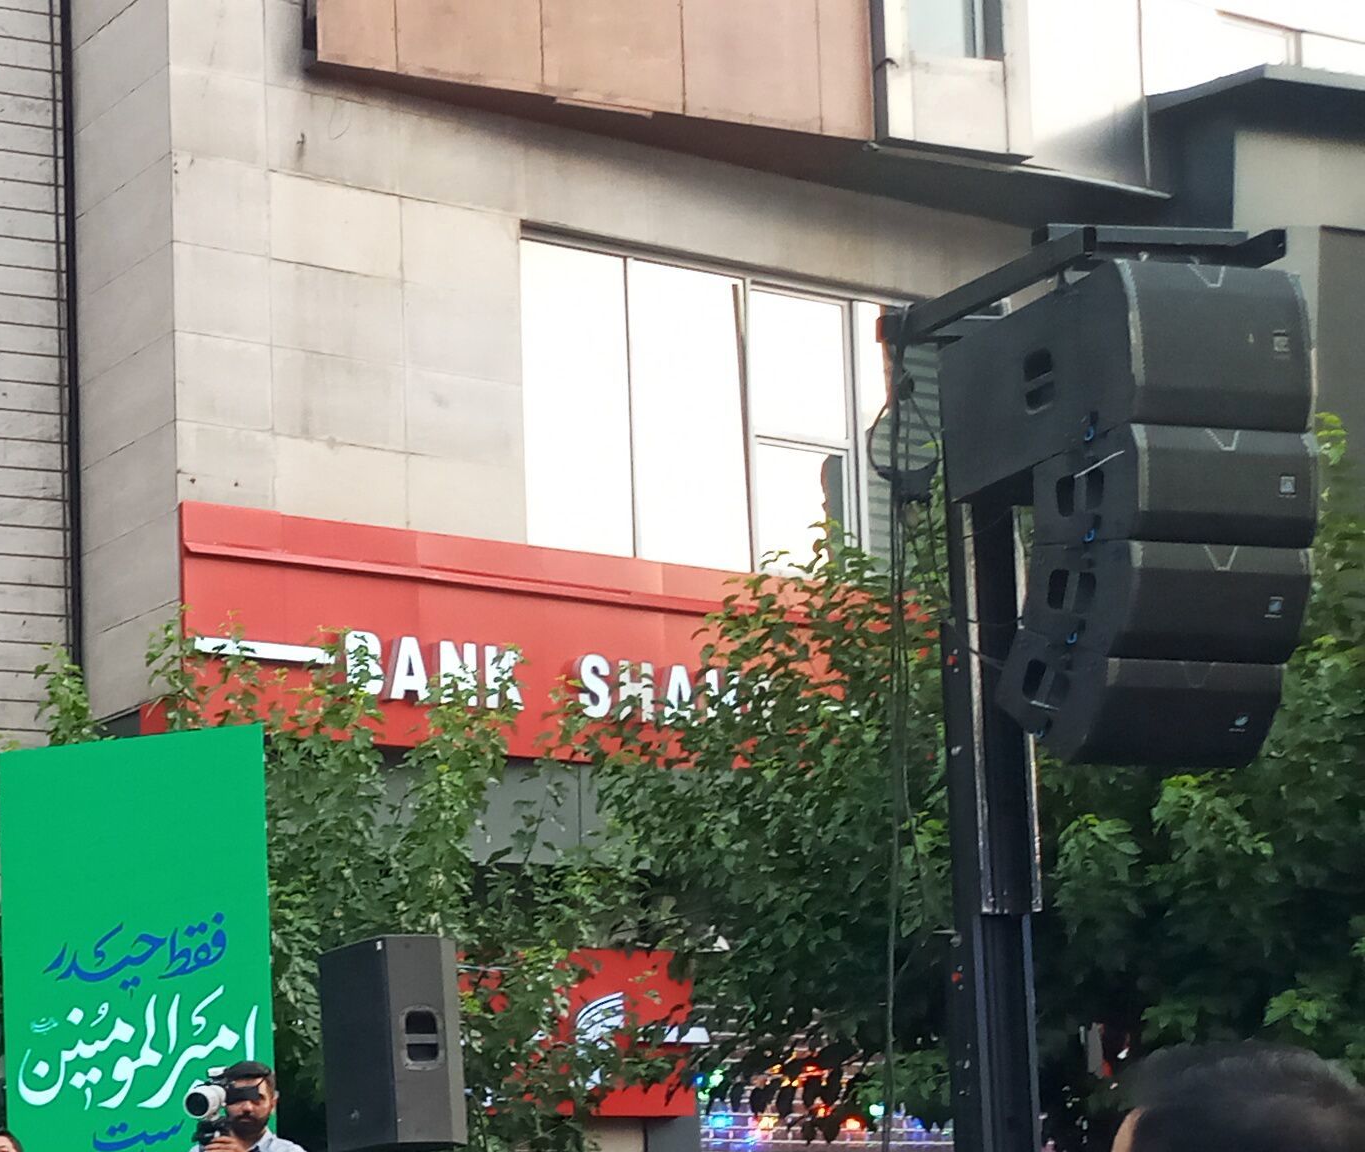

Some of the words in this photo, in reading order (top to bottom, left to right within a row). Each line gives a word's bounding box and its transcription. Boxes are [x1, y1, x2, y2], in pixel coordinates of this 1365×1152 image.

[345, 630, 524, 710] BANK
[43, 922, 168, 998] حیدر
[158, 911, 227, 980] فقط
